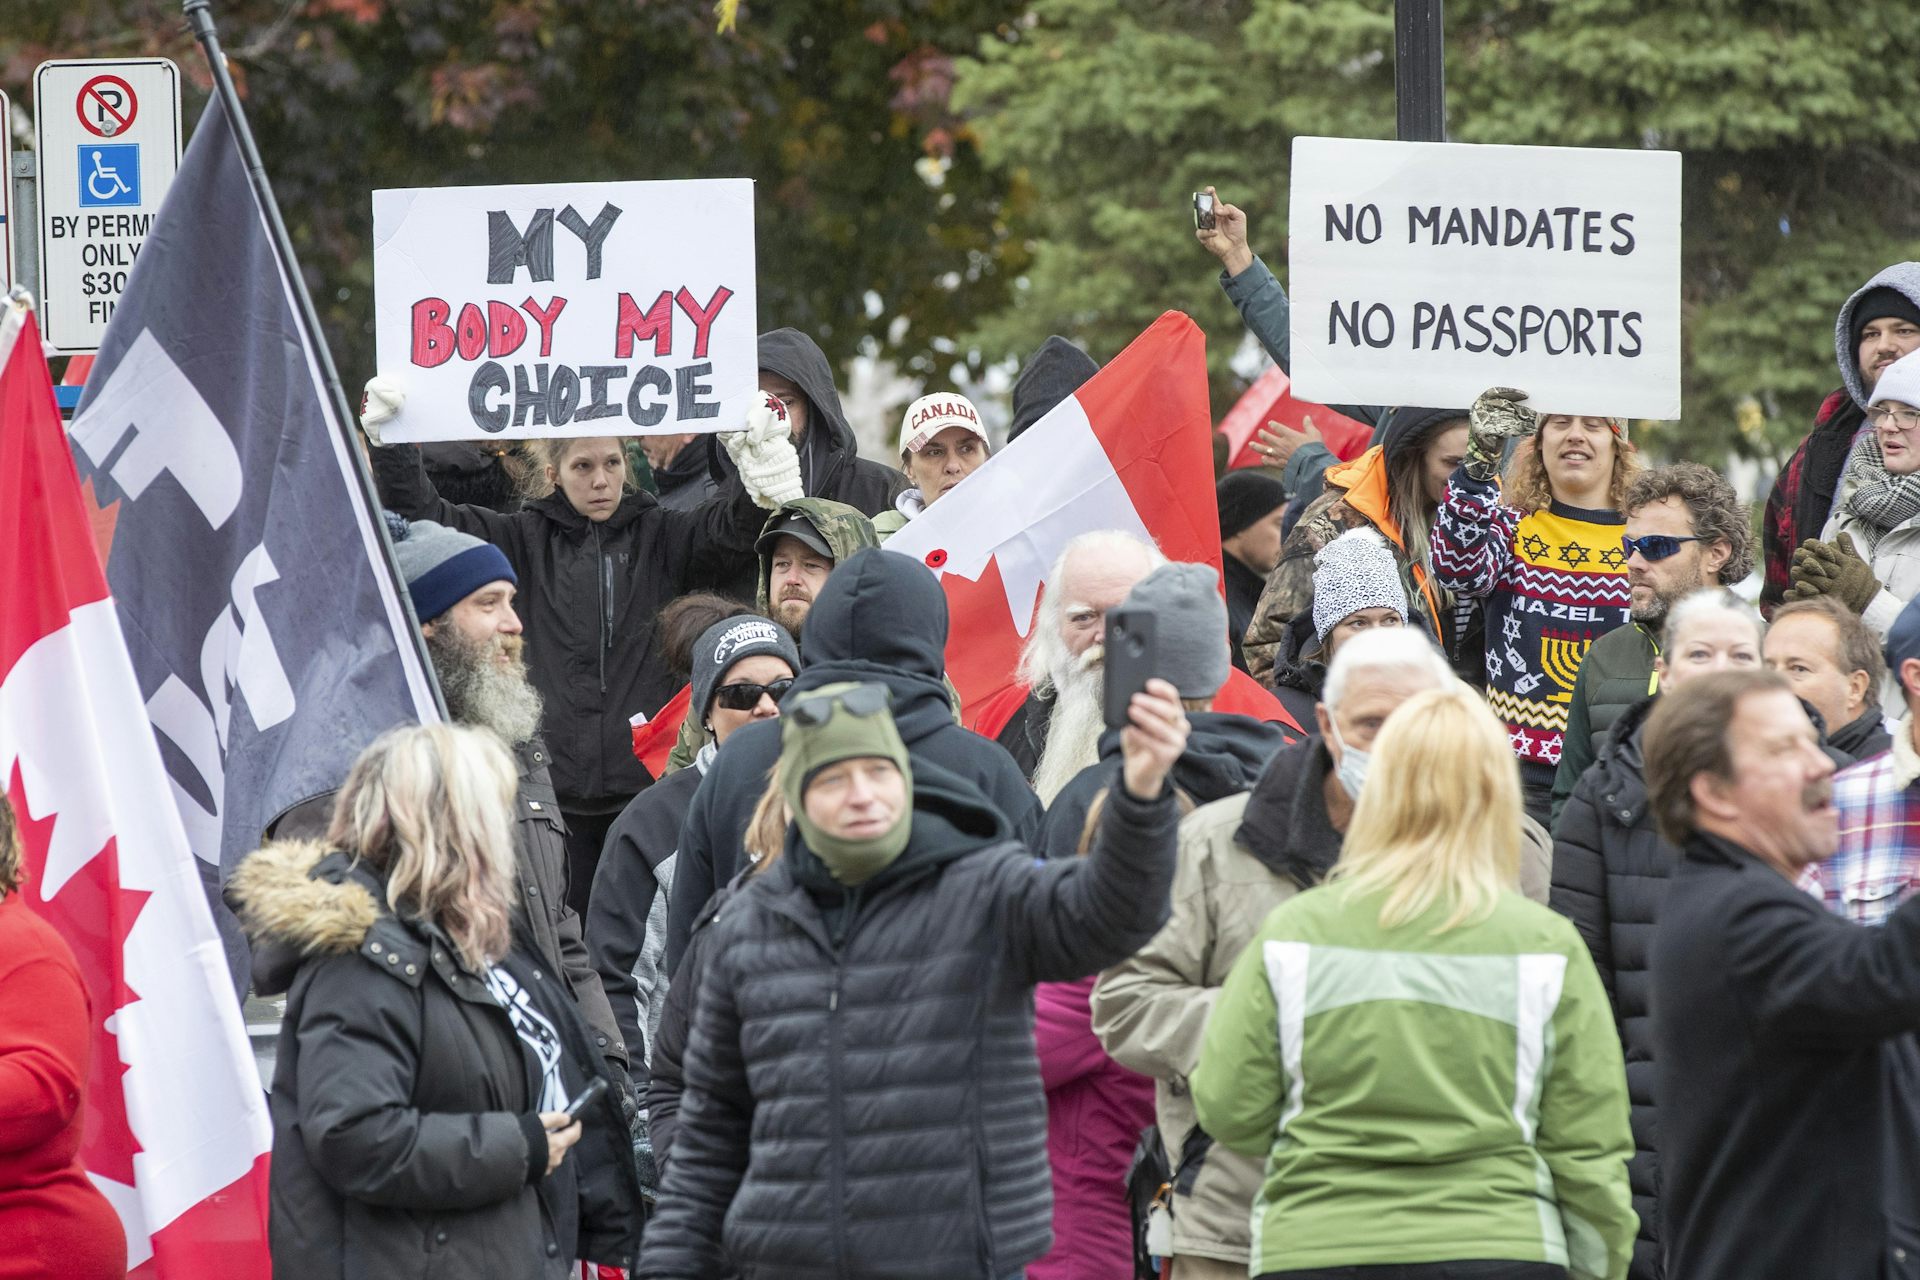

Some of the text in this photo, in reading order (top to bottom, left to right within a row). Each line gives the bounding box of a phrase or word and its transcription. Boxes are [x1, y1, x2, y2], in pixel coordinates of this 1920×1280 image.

[51, 215, 80, 238] BY
[487, 201, 623, 284] MY
[1325, 203, 1636, 256] NO MANDATES
[82, 242, 142, 267] ONLY
[410, 285, 734, 368] BODY MY
[1328, 300, 1643, 358] NO PASSPORTS
[468, 361, 721, 433] CHOICE
[911, 402, 978, 430] CANADA
[1511, 594, 1605, 622] MAZEL
[735, 628, 778, 643] UNITED
